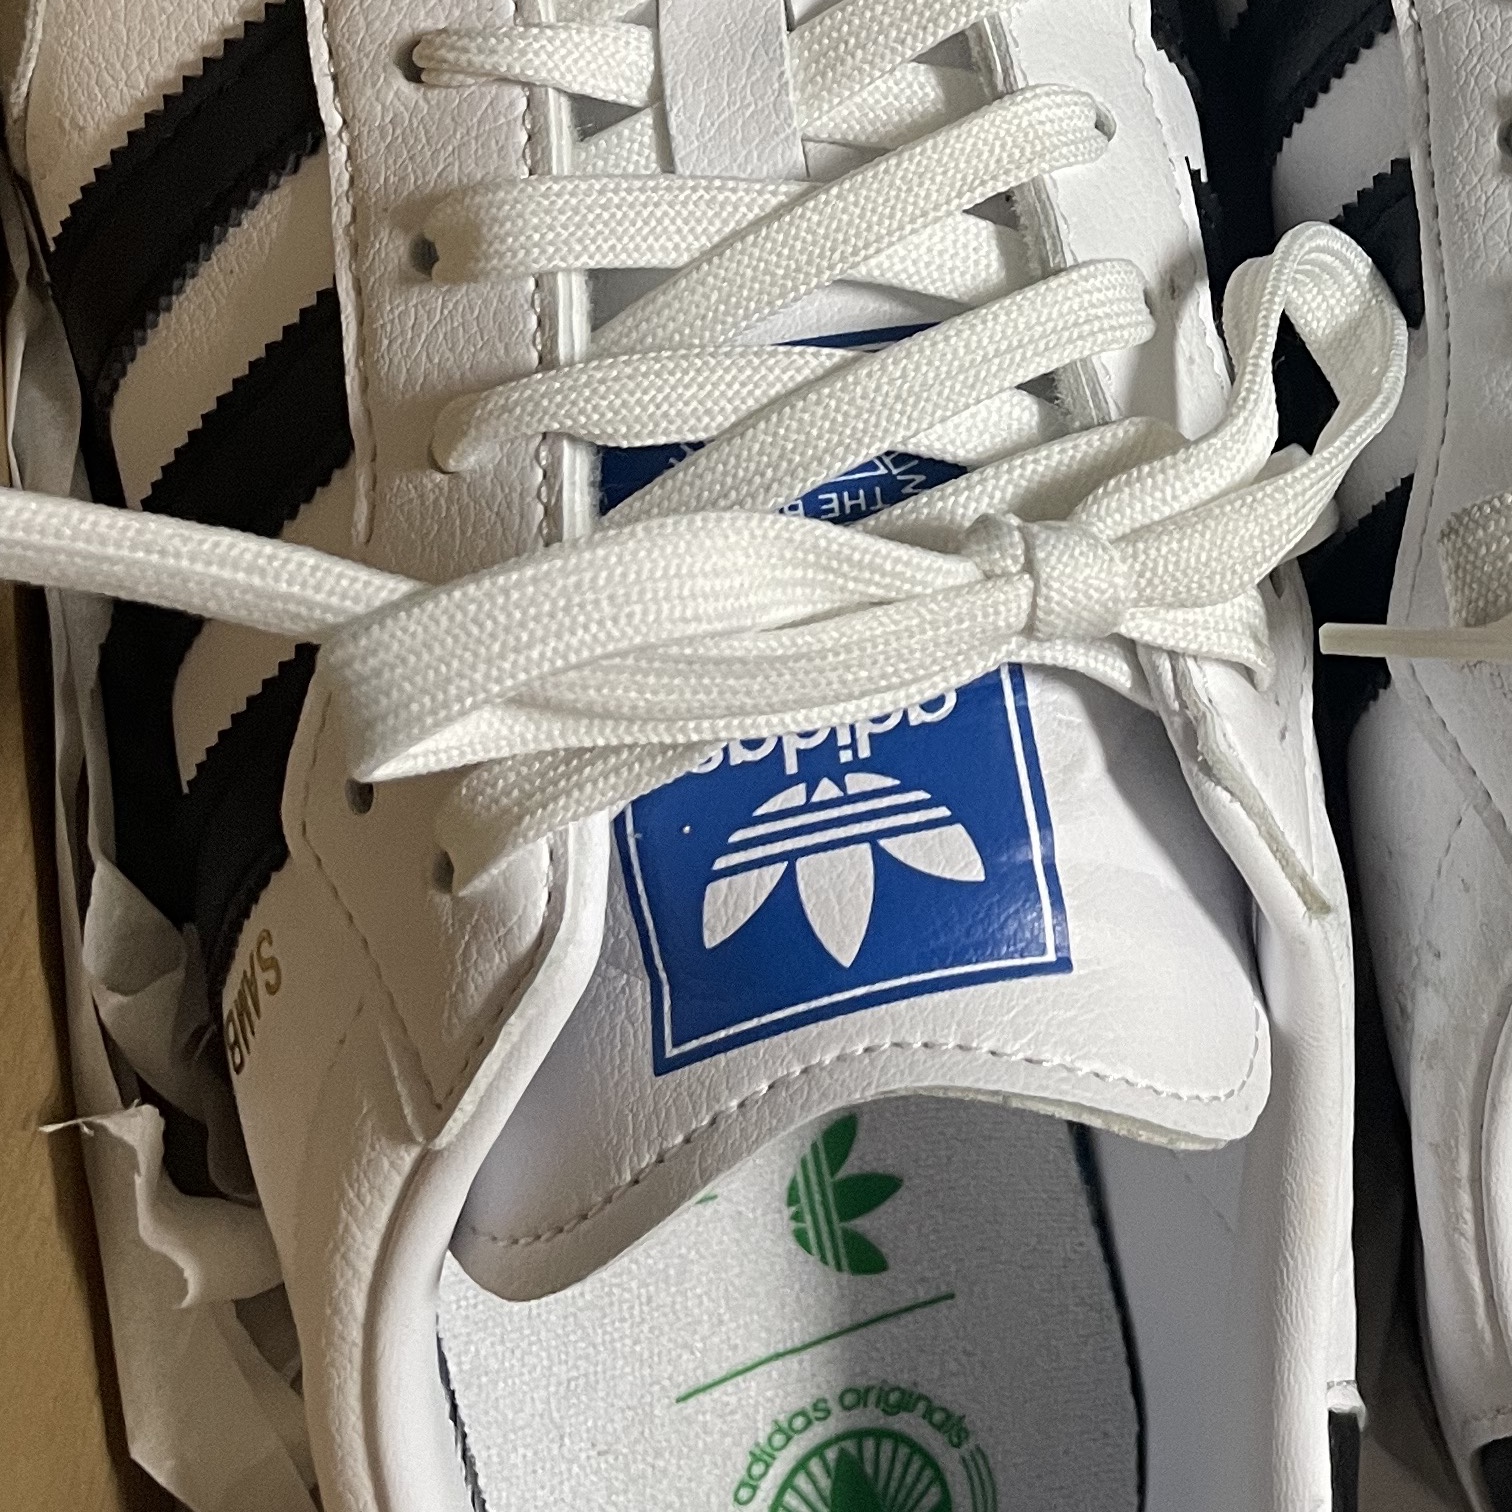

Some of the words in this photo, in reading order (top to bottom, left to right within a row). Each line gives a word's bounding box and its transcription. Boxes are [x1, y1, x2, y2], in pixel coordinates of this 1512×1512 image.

[818, 484, 888, 519] THE
[733, 1396, 832, 1506] adidas
[839, 1384, 970, 1449] originals
